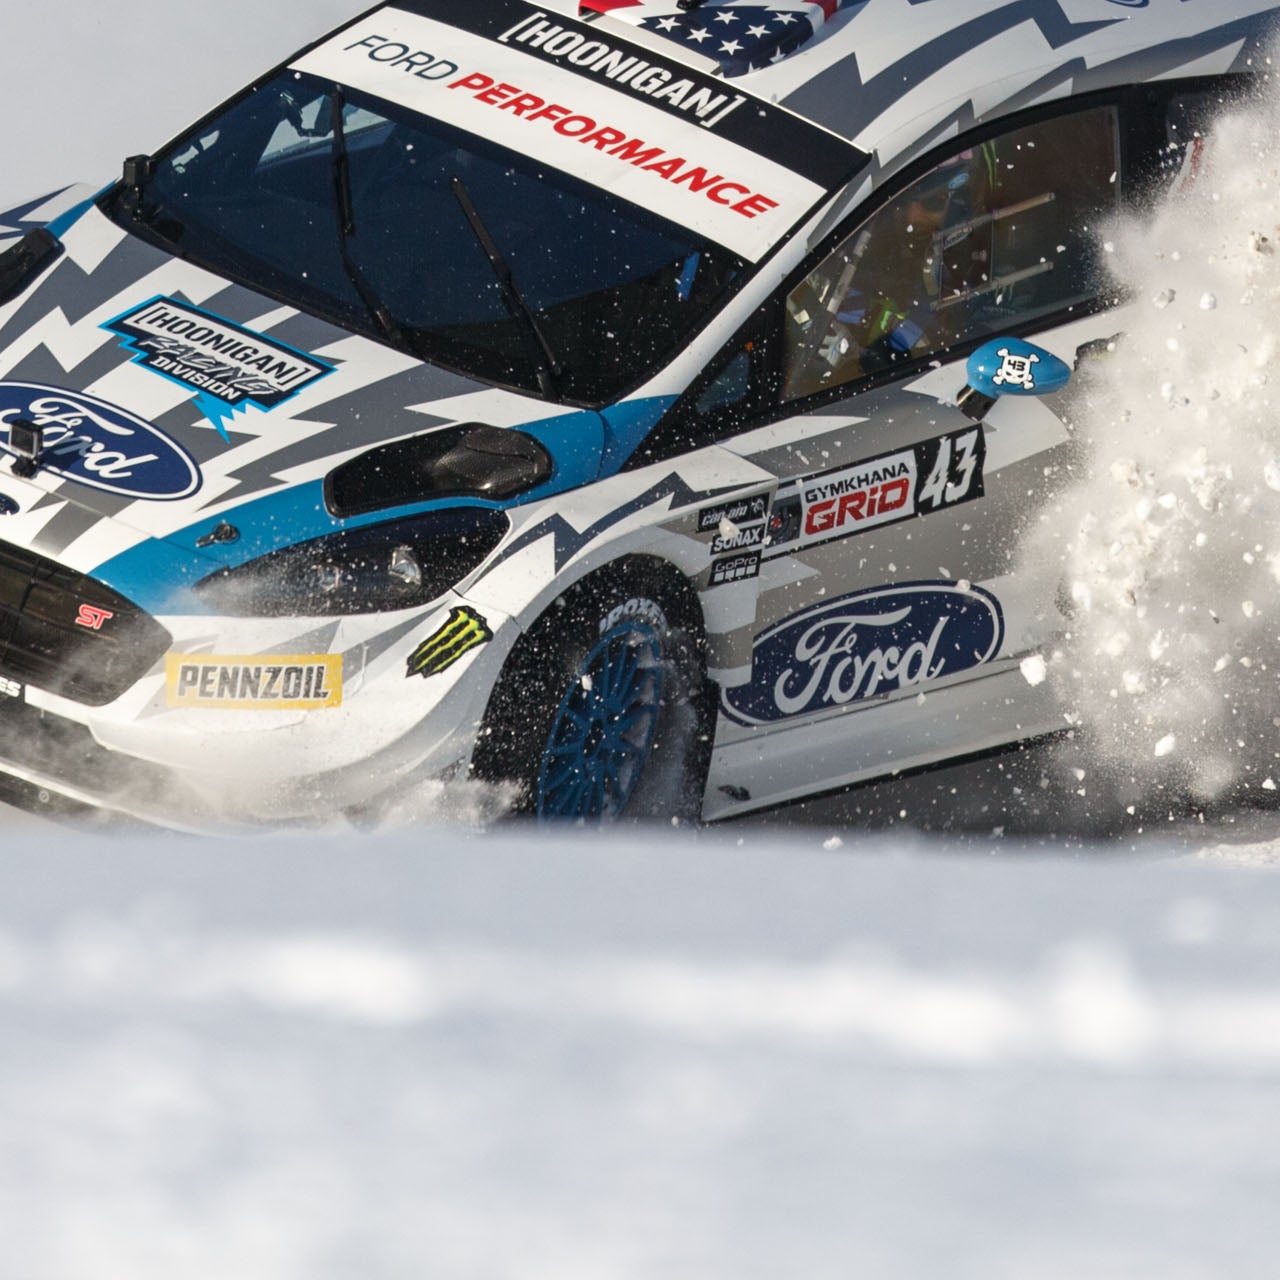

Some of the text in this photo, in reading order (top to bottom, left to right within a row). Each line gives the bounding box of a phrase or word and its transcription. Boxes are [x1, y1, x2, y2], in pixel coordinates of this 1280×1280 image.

[497, 12, 747, 129] [HOONIGAN]
[344, 34, 779, 219] FORD PERFORMANCE
[133, 306, 311, 387] [HOONIGAN]
[138, 335, 278, 395] RACING
[1007, 359, 1026, 372] 43
[150, 355, 242, 400] DIVISION
[805, 462, 910, 504] GYMKHANA
[918, 429, 979, 508] 43
[715, 556, 758, 572] GoPro
[75, 604, 113, 631] ST
[177, 663, 331, 702] PENNZOIL
[774, 605, 950, 714] Ford
